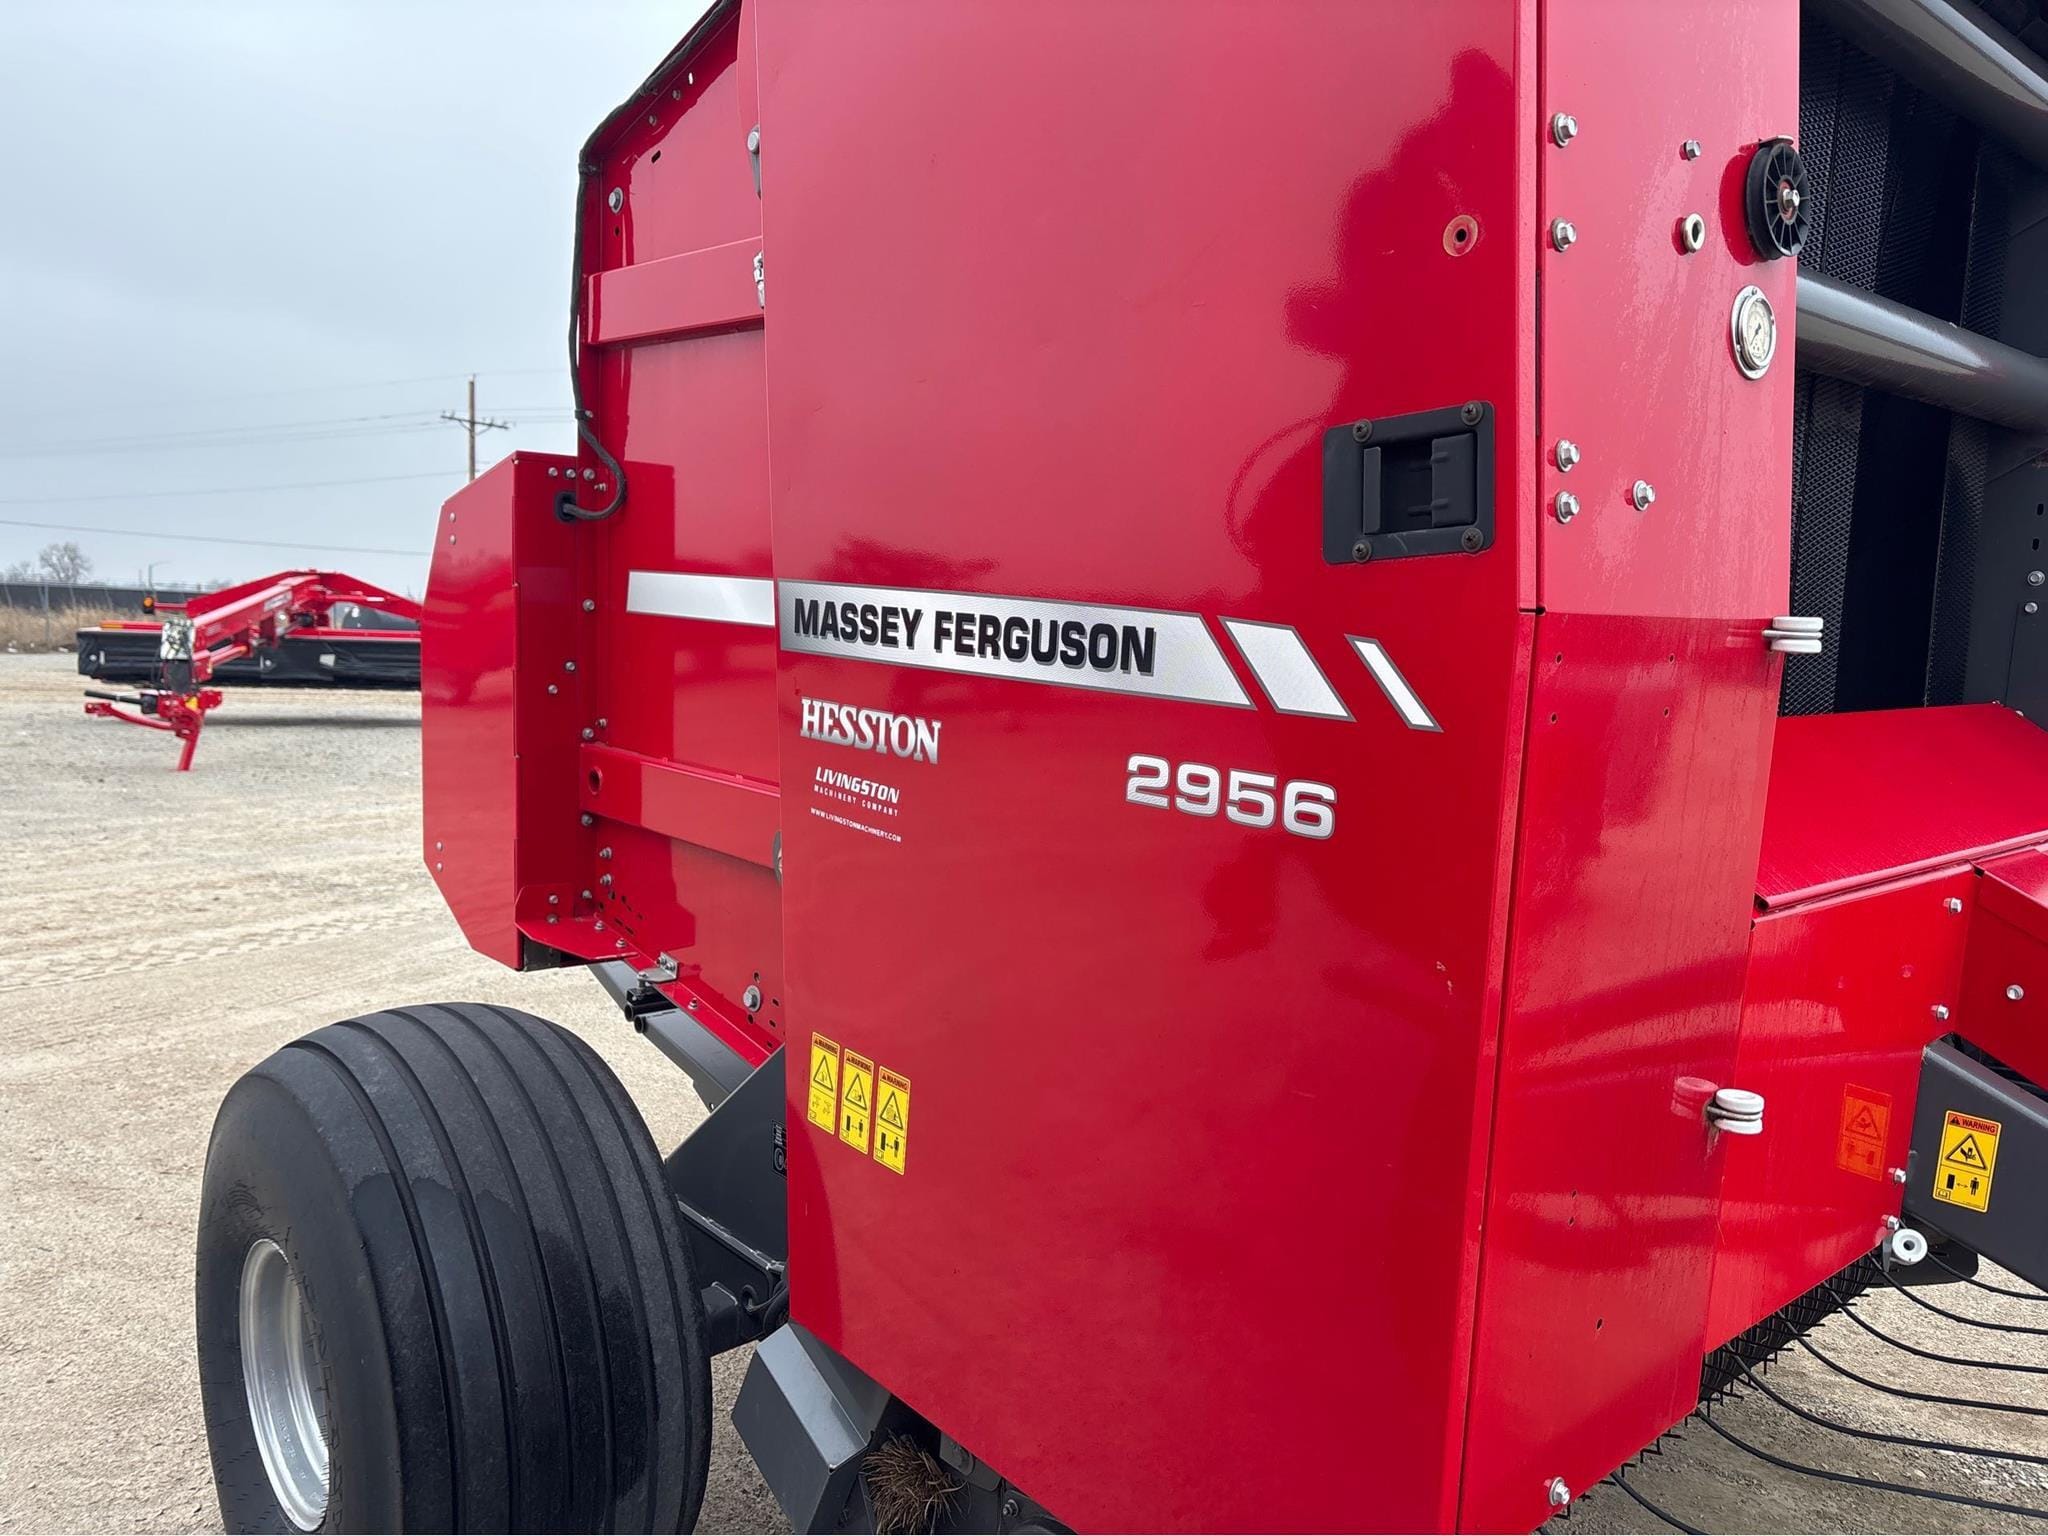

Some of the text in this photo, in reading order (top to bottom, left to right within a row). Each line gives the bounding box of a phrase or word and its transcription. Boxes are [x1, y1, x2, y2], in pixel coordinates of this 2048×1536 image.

[794, 598, 1157, 676] MASSEY FERGUSON
[800, 697, 941, 765] HESSTON
[814, 784, 898, 817] MACHINERY COMPANY
[815, 766, 900, 804] LIVINGSTON
[1126, 753, 1338, 840] 2956
[810, 807, 902, 842] WWW.LIVINGSTONMACHINERY.COM
[1962, 1119, 1996, 1133] WARNING
